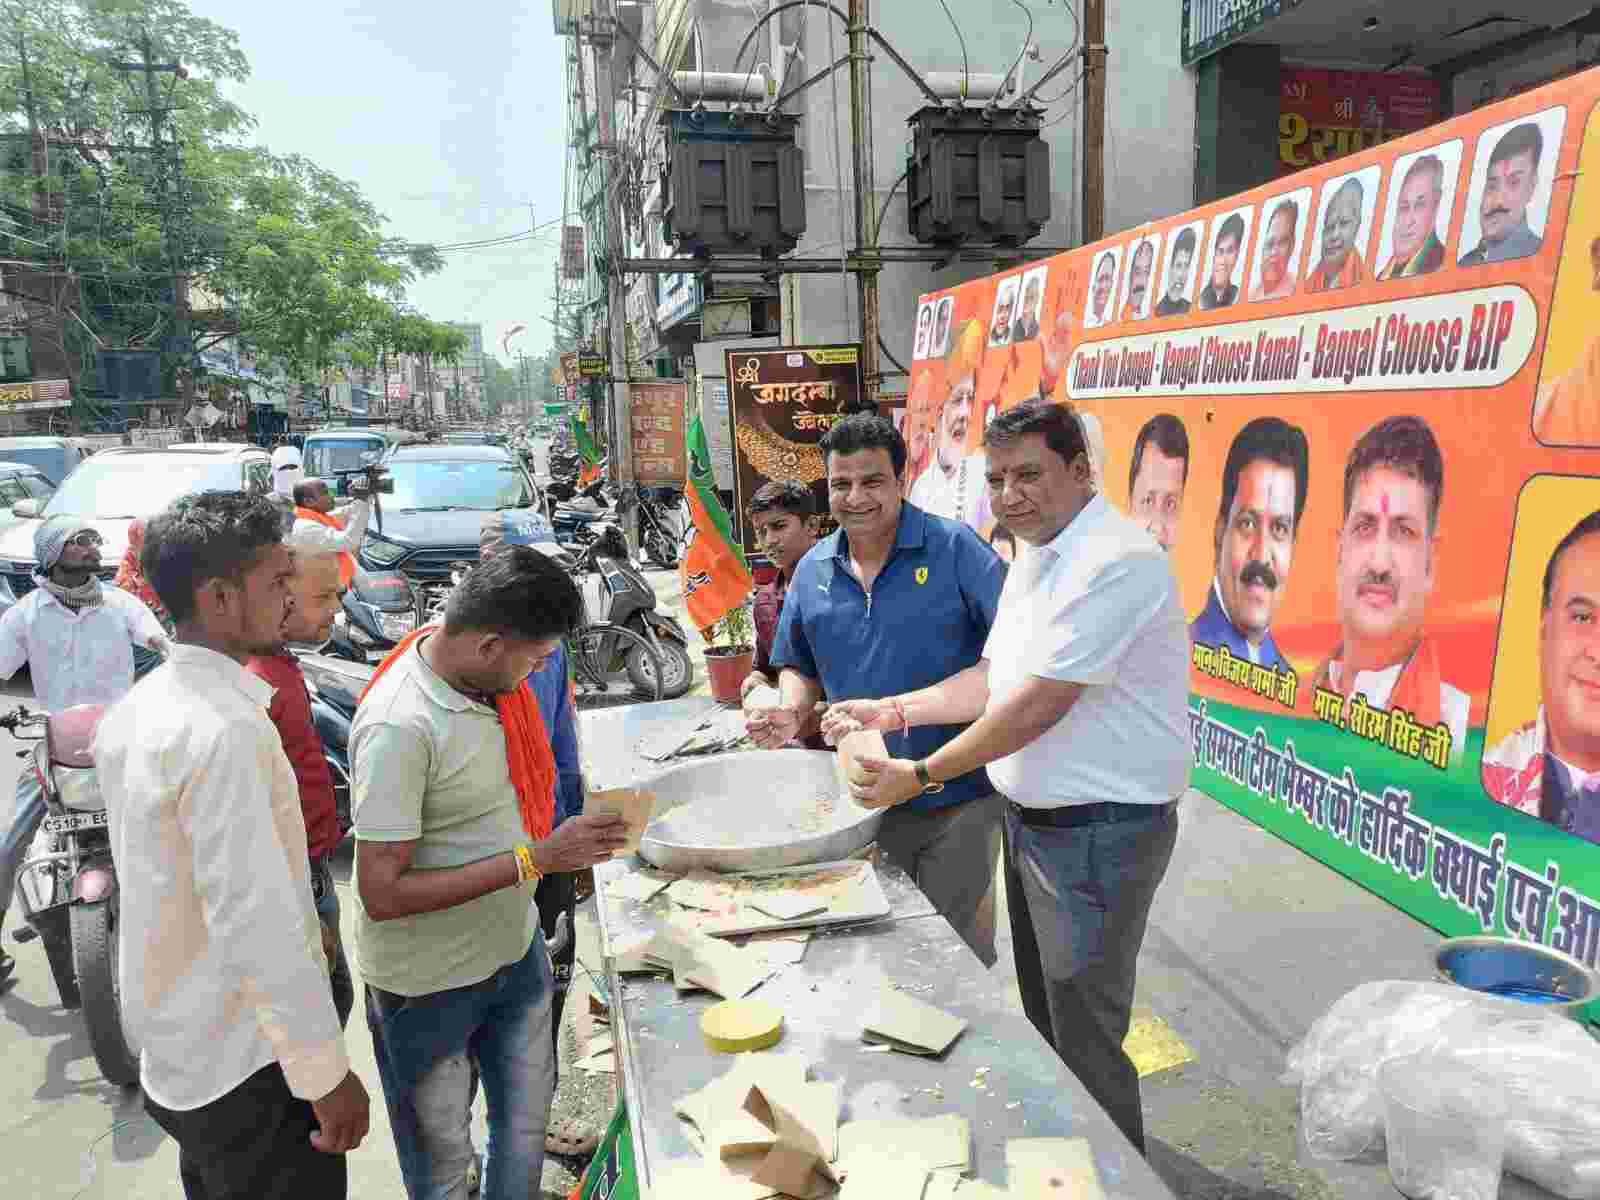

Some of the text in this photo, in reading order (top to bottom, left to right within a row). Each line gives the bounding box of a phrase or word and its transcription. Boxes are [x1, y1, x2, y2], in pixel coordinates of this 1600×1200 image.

[735, 358, 760, 389] श्री
[1073, 348, 1100, 391] Thank
[1100, 348, 1119, 388] You
[1118, 343, 1155, 391] Bangal
[1160, 337, 1202, 390] Bangal
[1202, 333, 1251, 384] Choose
[1251, 326, 1304, 382] Kamal
[1312, 316, 1381, 384] Bangal
[1379, 313, 1463, 375] Choose
[1463, 300, 1514, 371] BJP
[1216, 647, 1250, 688] विजय
[1250, 663, 1278, 700] शर्मा
[1278, 669, 1297, 708] जी
[1313, 688, 1345, 730] मान.
[1390, 706, 1424, 759] सिंह
[1423, 721, 1452, 770] जी
[1204, 715, 1249, 786] समस्त
[1248, 726, 1281, 803] टीम
[1328, 766, 1360, 846] को
[1360, 786, 1432, 882] हार्दिक
[1430, 832, 1507, 932] बधाई
[1503, 858, 1559, 943] एवं
[1552, 885, 1600, 975] आ
